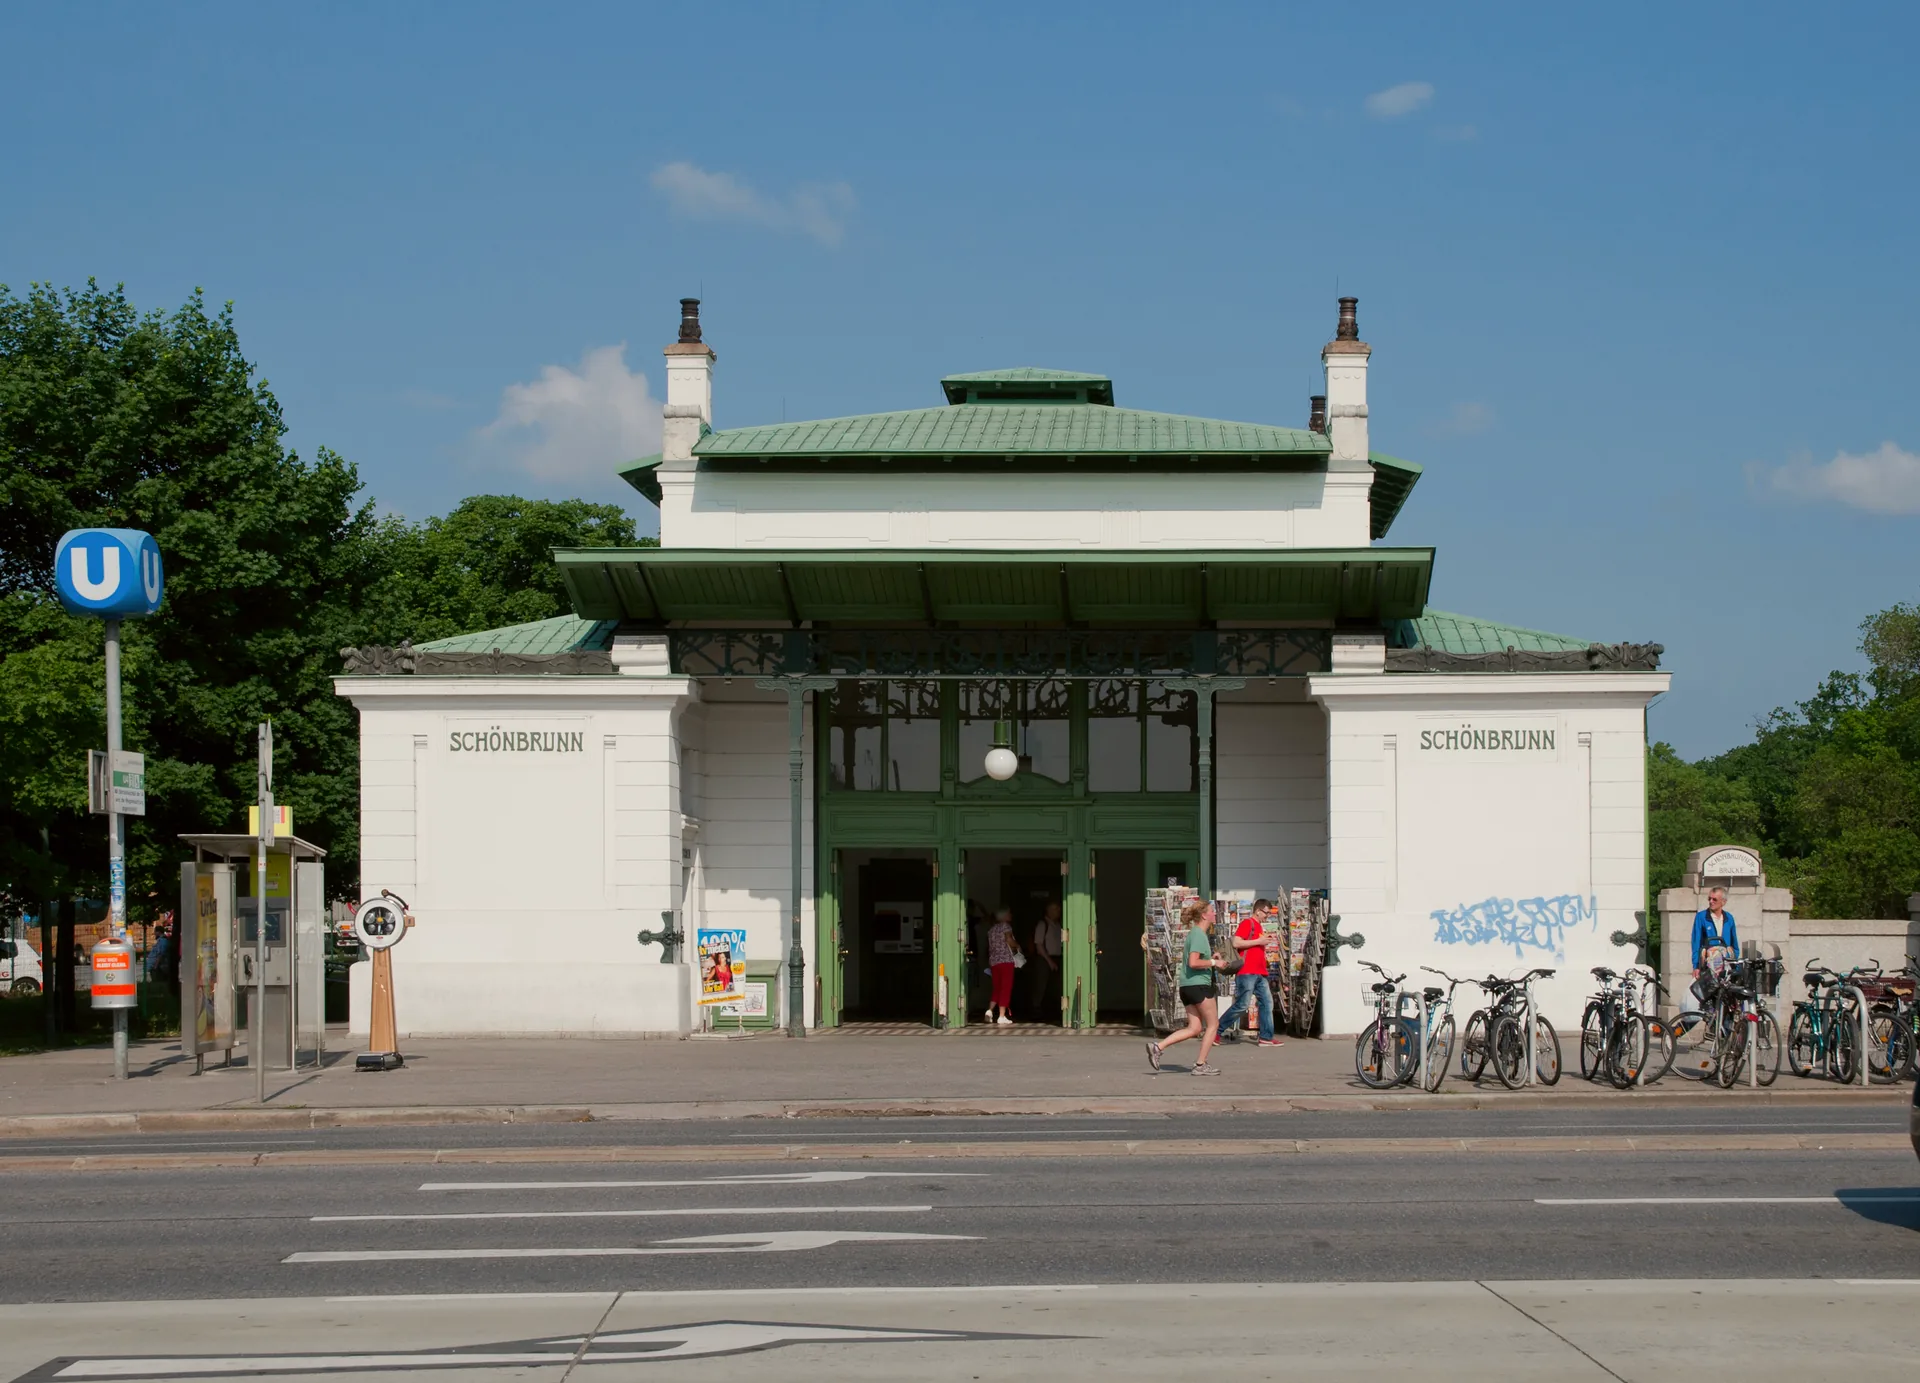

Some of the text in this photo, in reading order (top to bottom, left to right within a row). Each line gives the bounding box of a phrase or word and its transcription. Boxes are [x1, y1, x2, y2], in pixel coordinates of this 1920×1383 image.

[71, 546, 120, 601] U
[142, 548, 160, 604] U
[450, 725, 584, 753] SCHÖNBRUNN
[1420, 723, 1556, 750] SCHÖNBRUNN
